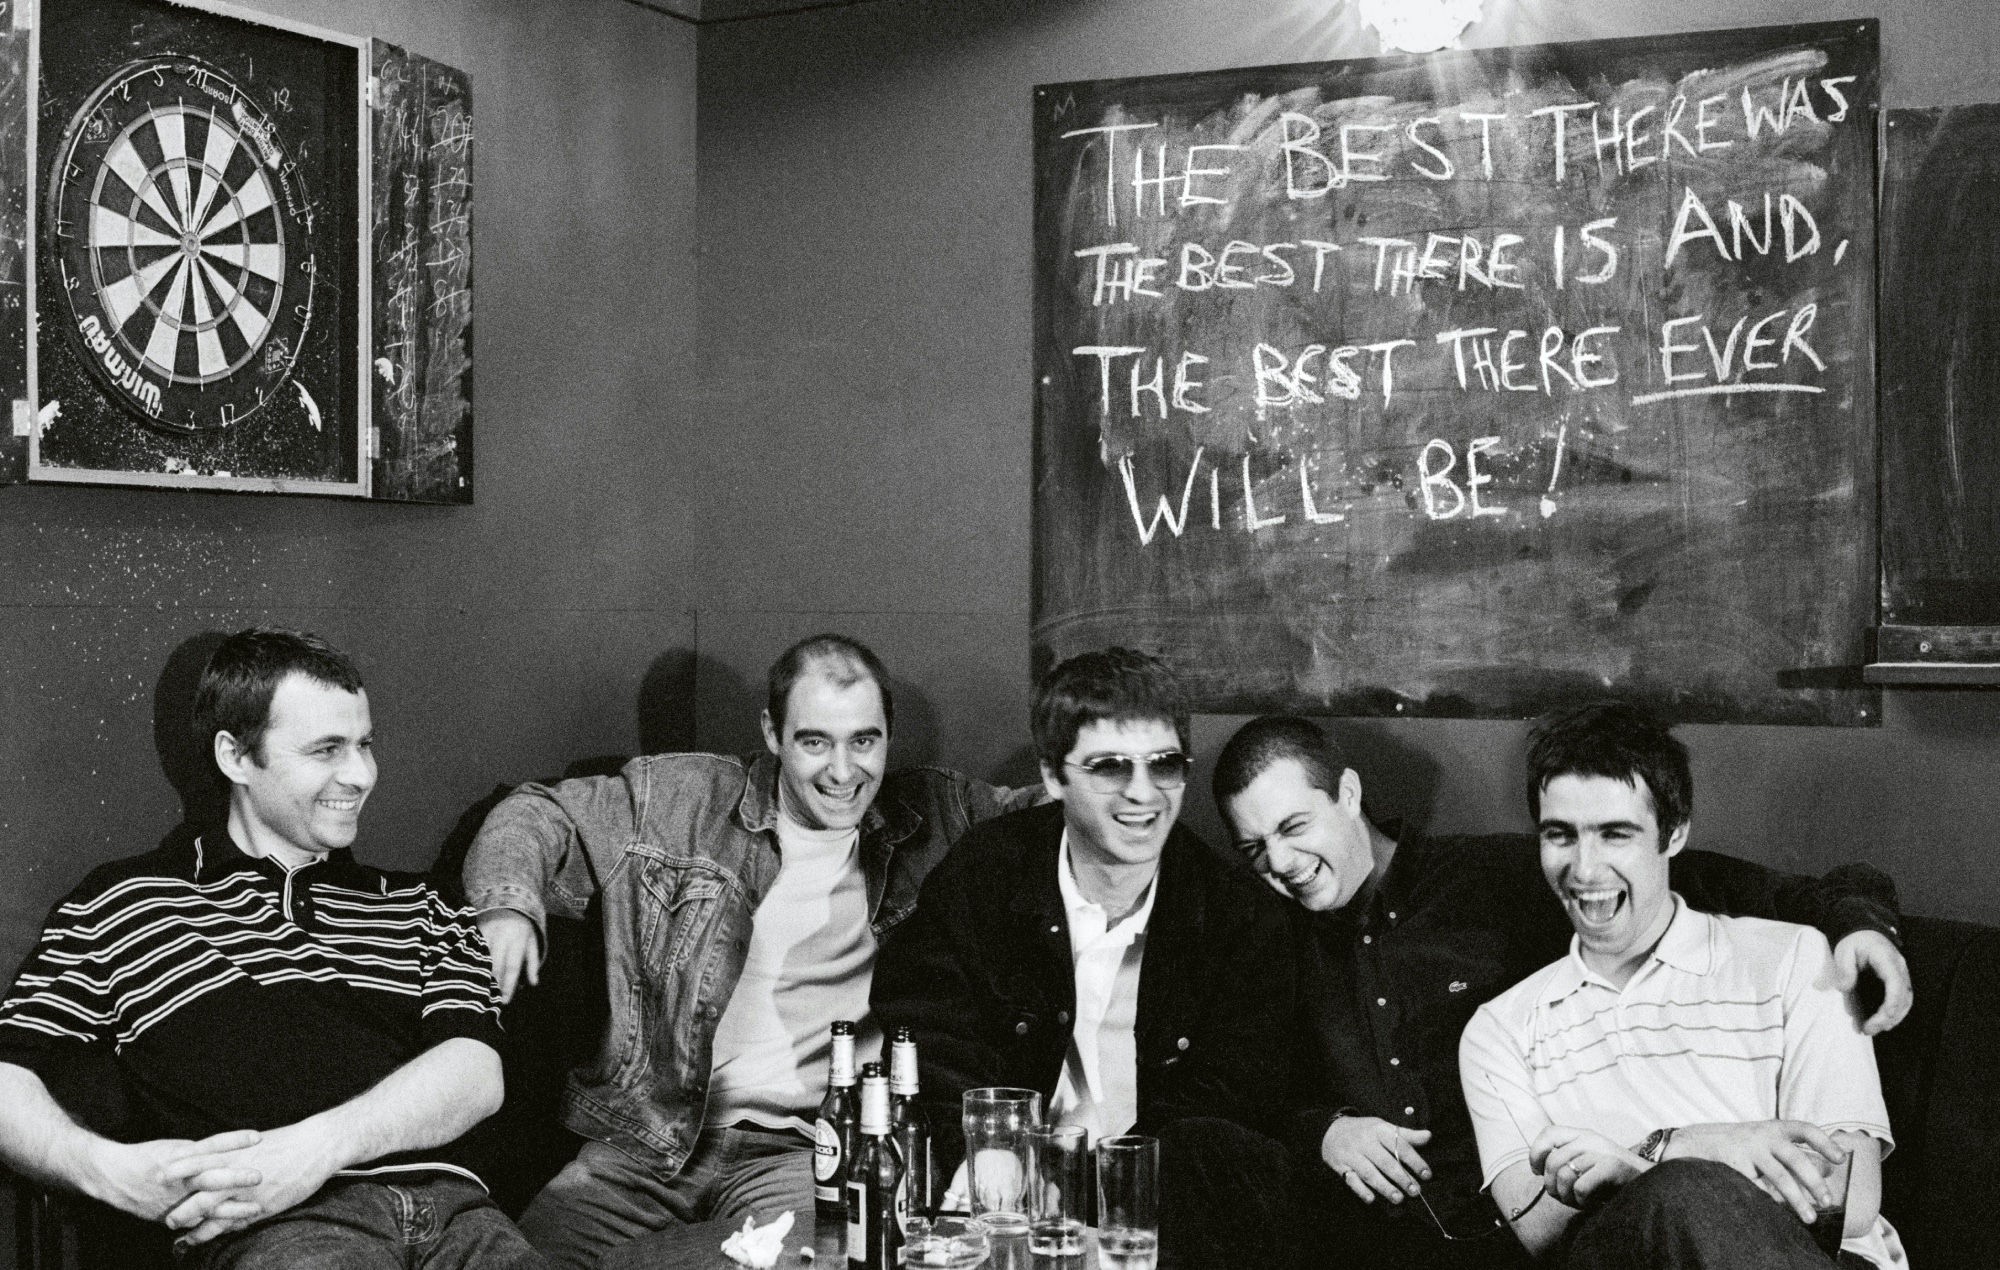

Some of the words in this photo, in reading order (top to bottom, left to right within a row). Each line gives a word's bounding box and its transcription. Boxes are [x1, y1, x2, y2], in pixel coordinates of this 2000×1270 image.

[1060, 121, 1244, 227] THE
[1280, 111, 1507, 200] BEST
[1526, 92, 1735, 184] THERE
[1741, 75, 1857, 142] WAS
[1074, 242, 1168, 306] THE
[1175, 239, 1342, 294] BEST
[1357, 233, 1526, 297] THERE
[1553, 217, 1618, 290] IS
[1663, 186, 1850, 269] AND,
[1072, 345, 1212, 420] THE
[1252, 339, 1416, 421] BEST
[1435, 325, 1621, 396] THERE
[1659, 303, 1827, 385] EVER
[1117, 446, 1345, 546] WILL
